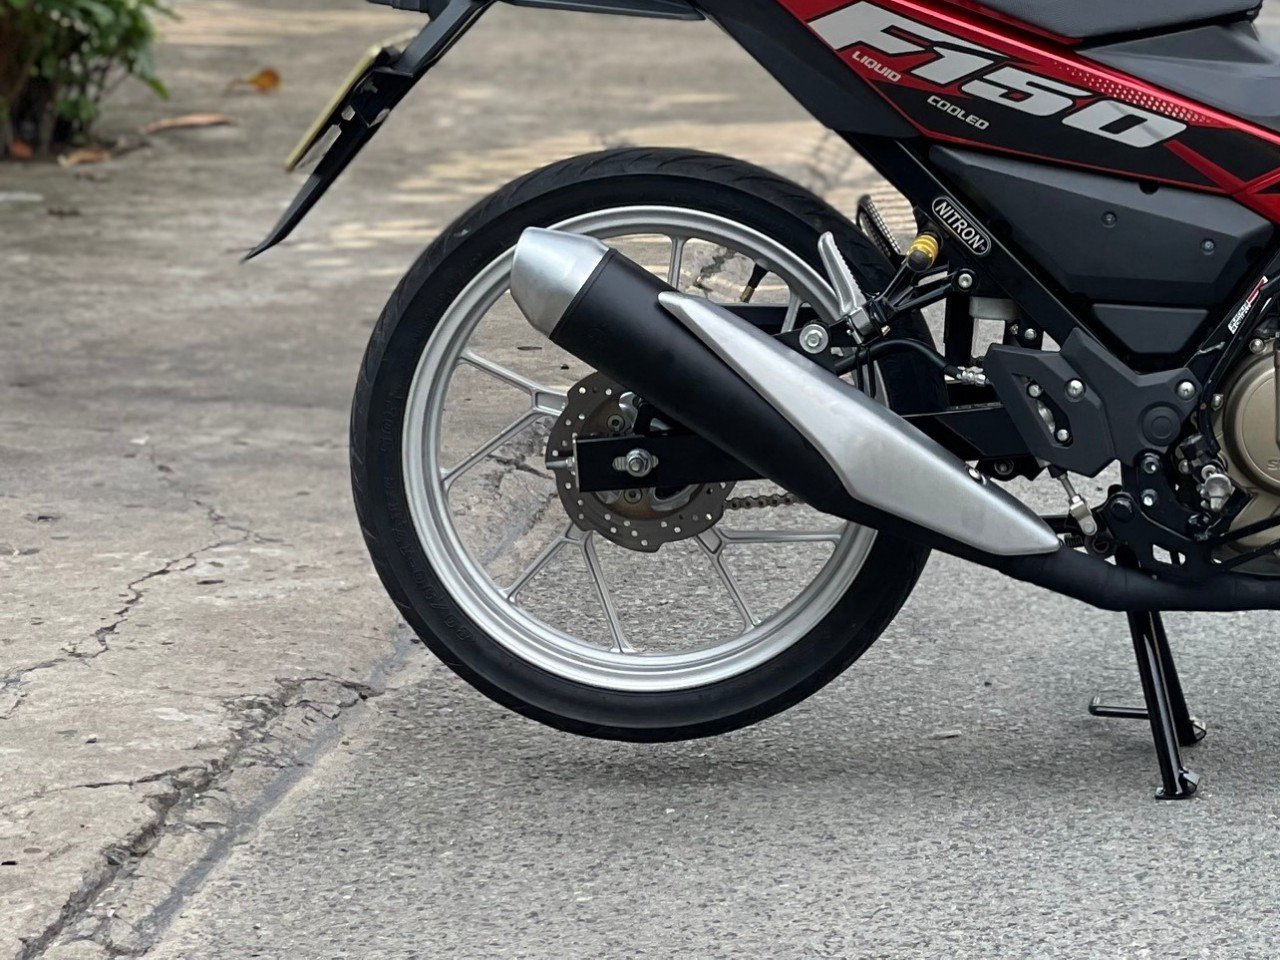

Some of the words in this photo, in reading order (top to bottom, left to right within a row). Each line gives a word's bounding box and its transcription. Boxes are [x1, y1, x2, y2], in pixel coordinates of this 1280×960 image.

[851, 50, 902, 83] LIQUID
[927, 94, 990, 131] COOLED
[935, 201, 985, 249] NITRON
